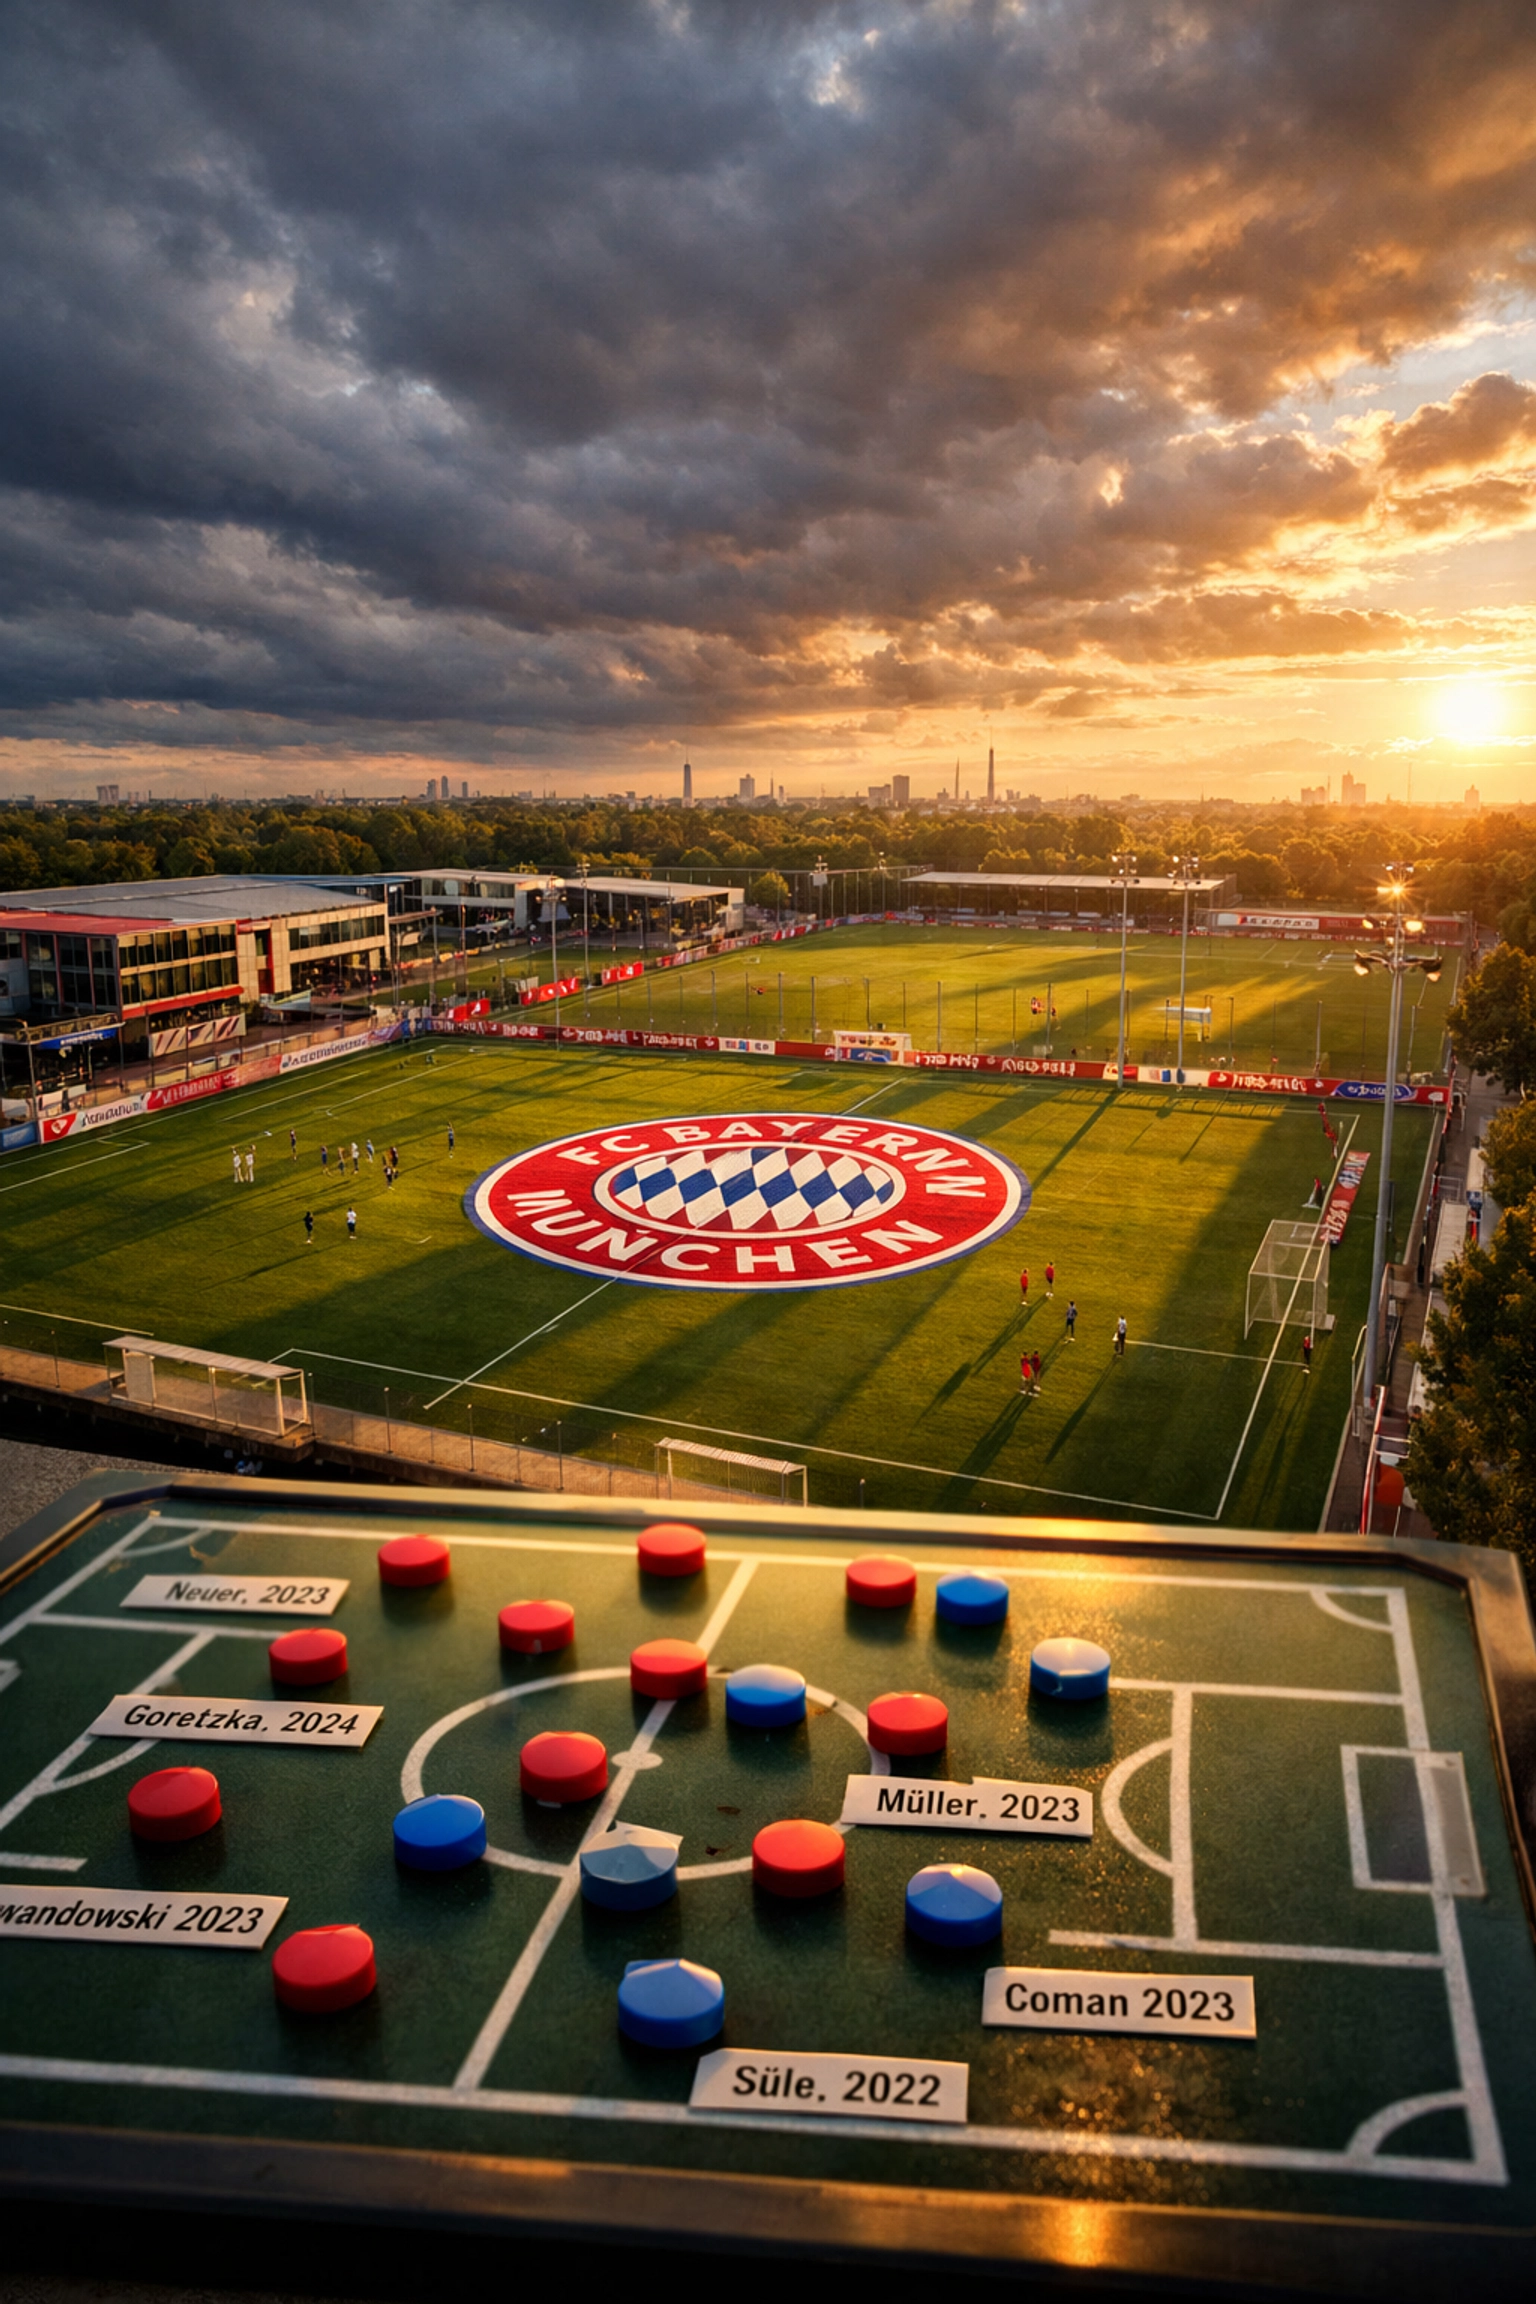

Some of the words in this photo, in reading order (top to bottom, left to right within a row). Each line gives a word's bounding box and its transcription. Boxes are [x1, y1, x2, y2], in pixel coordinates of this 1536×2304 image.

[556, 1135, 650, 1166] FC
[258, 1584, 331, 1605] 2023
[280, 1711, 360, 1735] 2024
[1000, 1793, 1081, 1823] 2023
[173, 1904, 265, 1934] 2023
[1005, 1982, 1129, 2017] Coman
[1142, 1988, 1235, 2022] 2023
[841, 2070, 942, 2107] 2022
